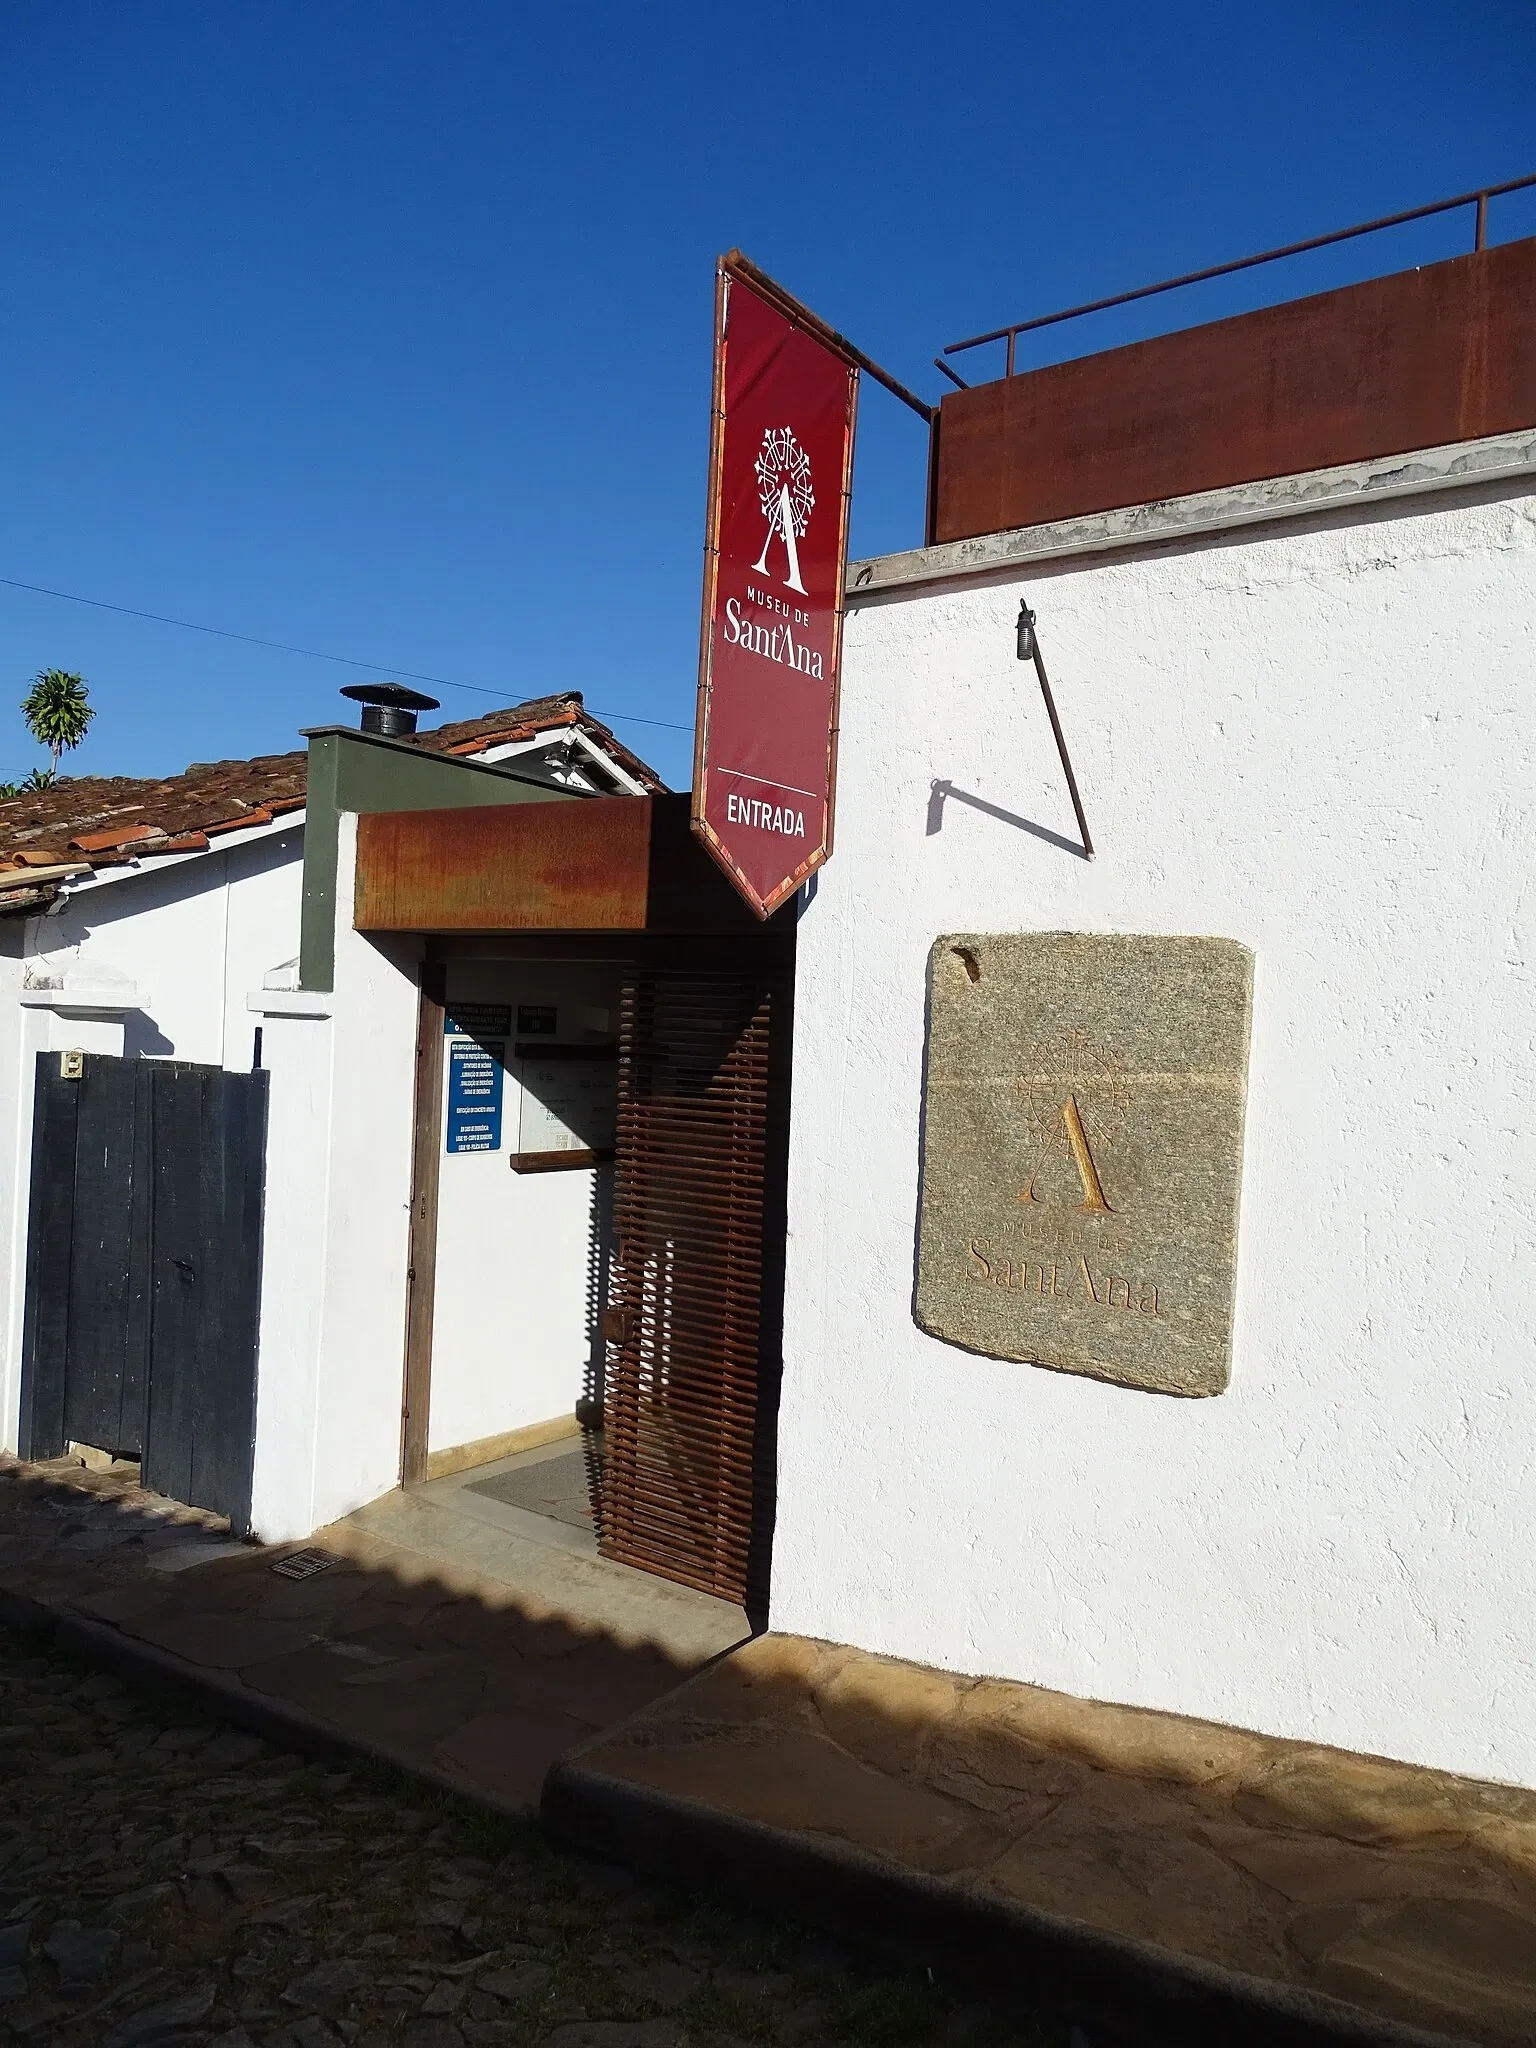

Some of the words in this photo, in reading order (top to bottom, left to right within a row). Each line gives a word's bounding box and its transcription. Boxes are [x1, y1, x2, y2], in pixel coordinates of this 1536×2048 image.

[746, 585, 790, 619] MUSEU
[793, 607, 811, 628] DE
[723, 597, 824, 681] Sant'Ana
[727, 794, 805, 838] ENTRADA
[1003, 1221, 1083, 1245] MUSEU
[1099, 1235, 1130, 1252] DE
[965, 1235, 1164, 1317] Sant'Ana
